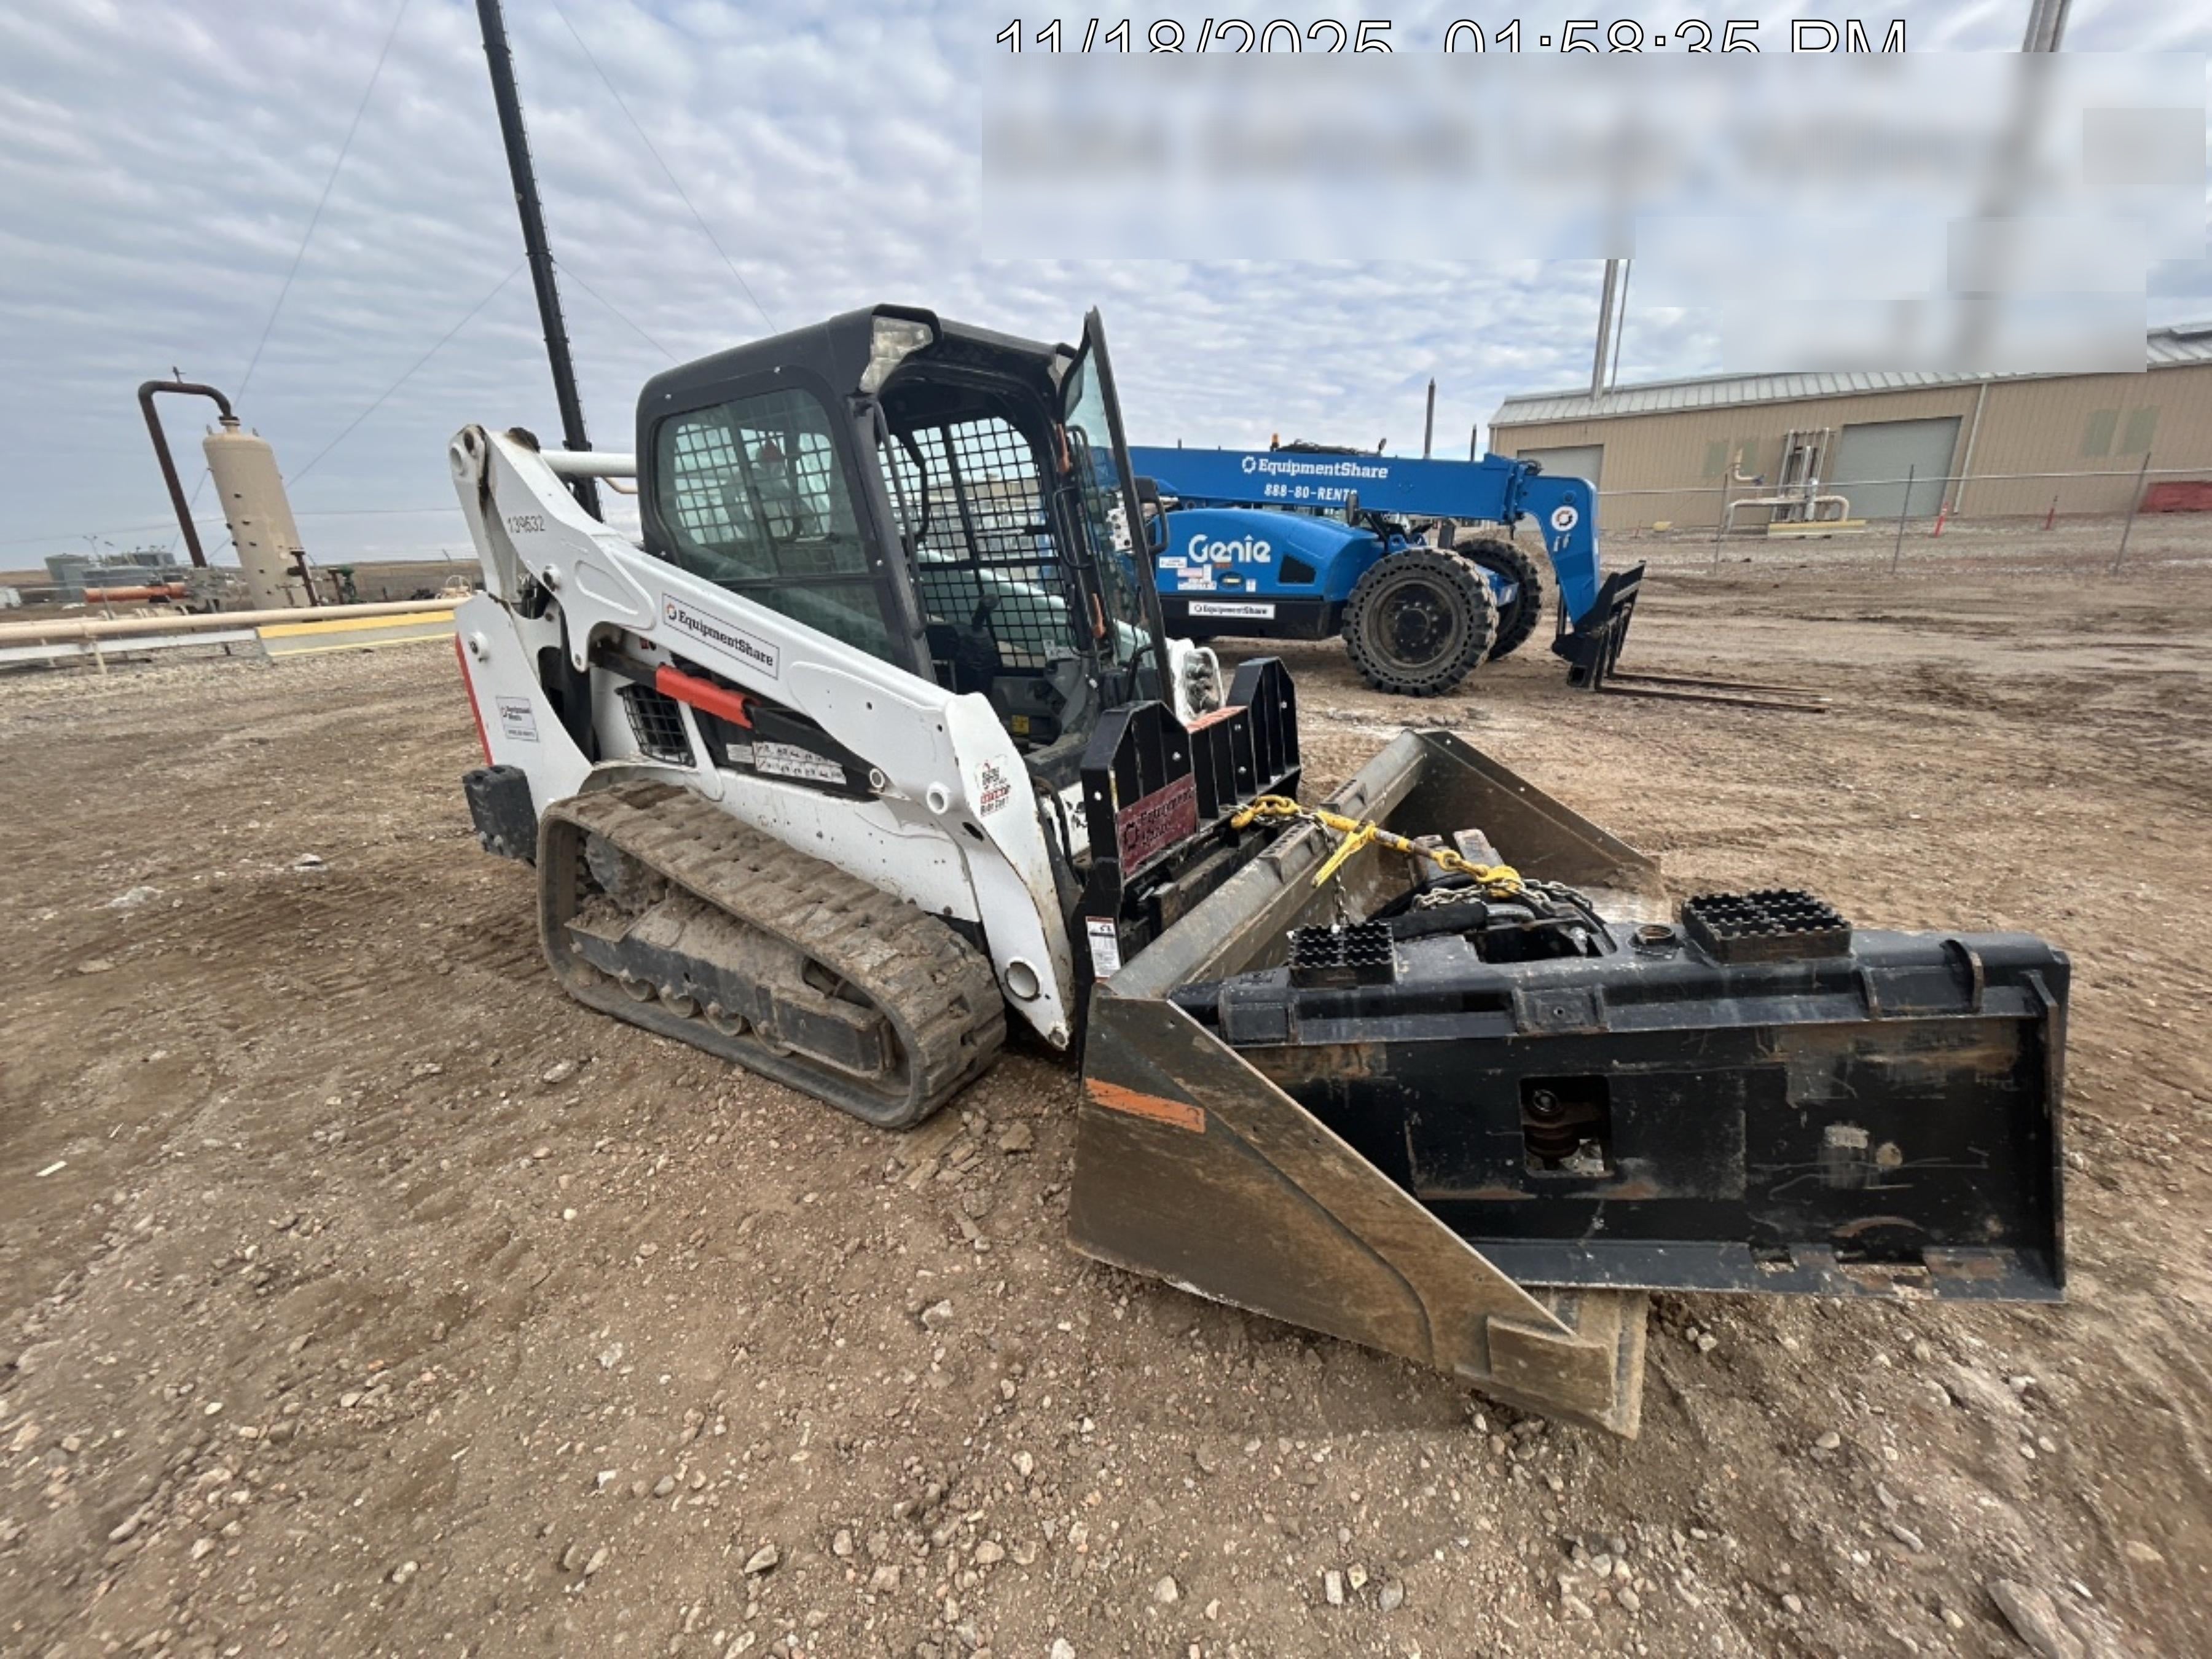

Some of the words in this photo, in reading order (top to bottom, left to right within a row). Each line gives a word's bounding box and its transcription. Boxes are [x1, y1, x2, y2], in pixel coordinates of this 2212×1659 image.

[1258, 458, 1389, 479] EquipmentShare
[1188, 534, 1271, 563] Genie
[678, 610, 774, 667] EquipmentShare
